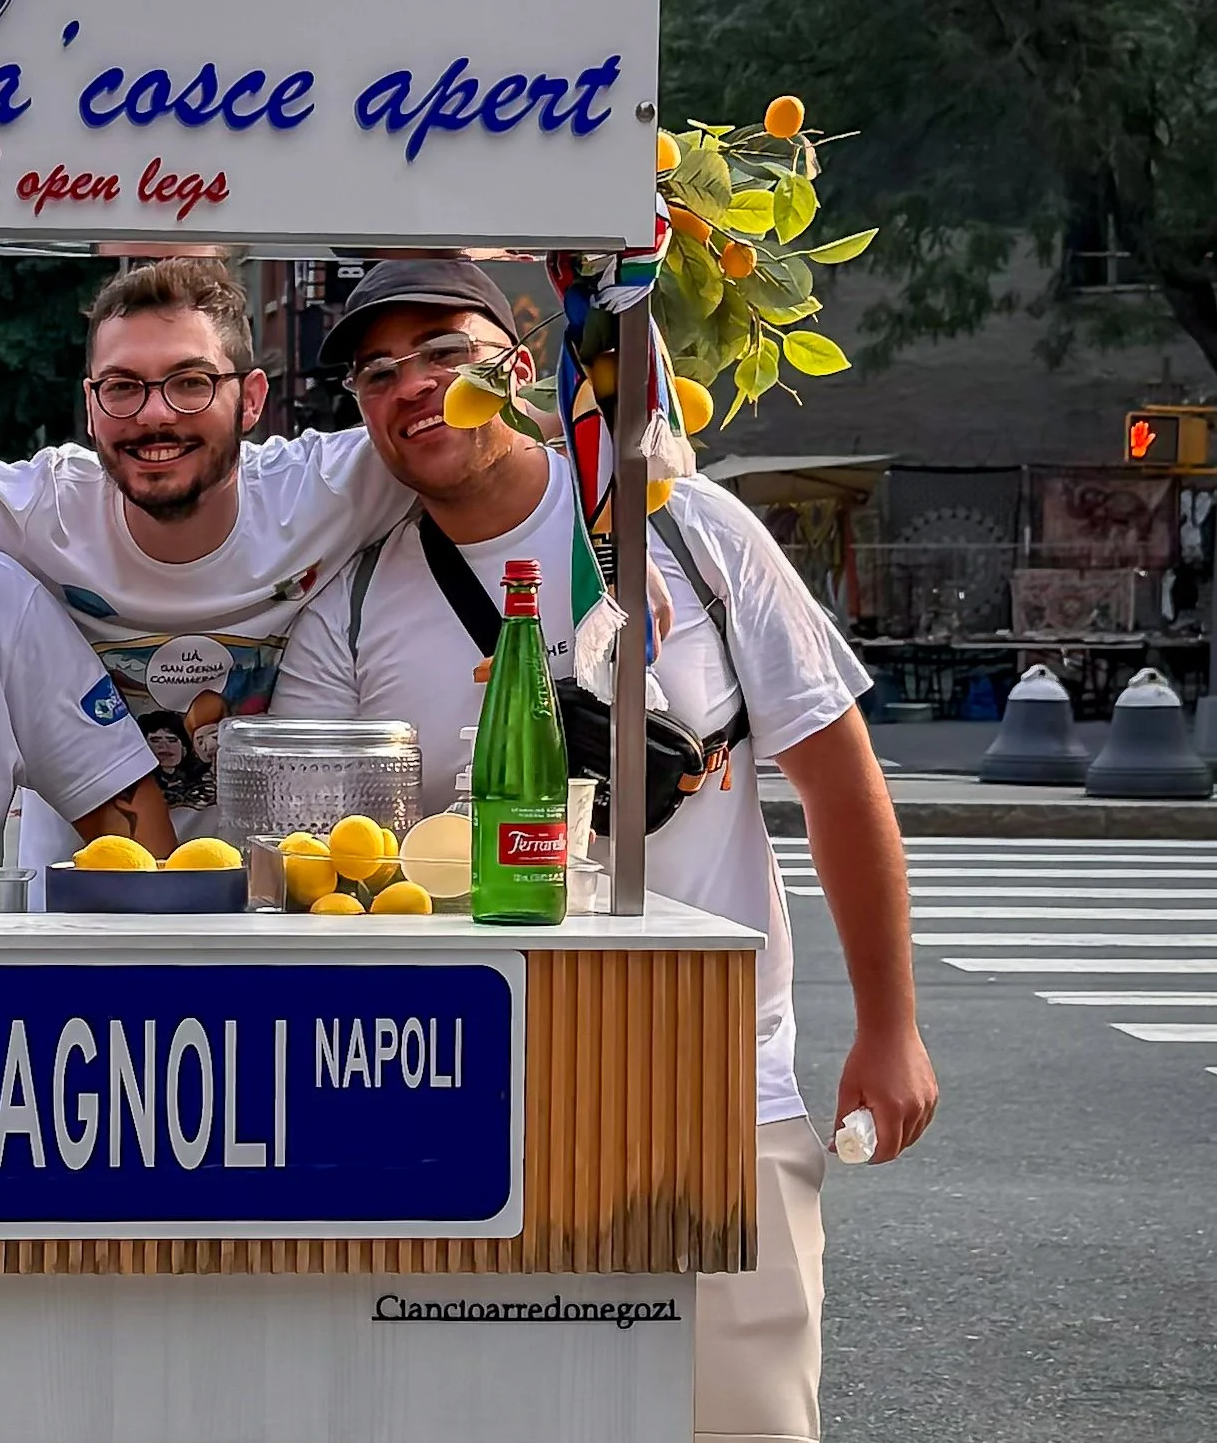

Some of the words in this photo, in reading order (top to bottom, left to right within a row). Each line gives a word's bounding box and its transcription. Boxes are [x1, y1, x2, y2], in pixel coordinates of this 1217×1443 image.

[78, 61, 316, 132] cosce
[353, 54, 623, 164] apert
[16, 164, 122, 217] open
[137, 157, 231, 222] legs
[314, 1016, 463, 1088] NAPOLI
[374, 1294, 678, 1329] Ciancioarredonegozi
